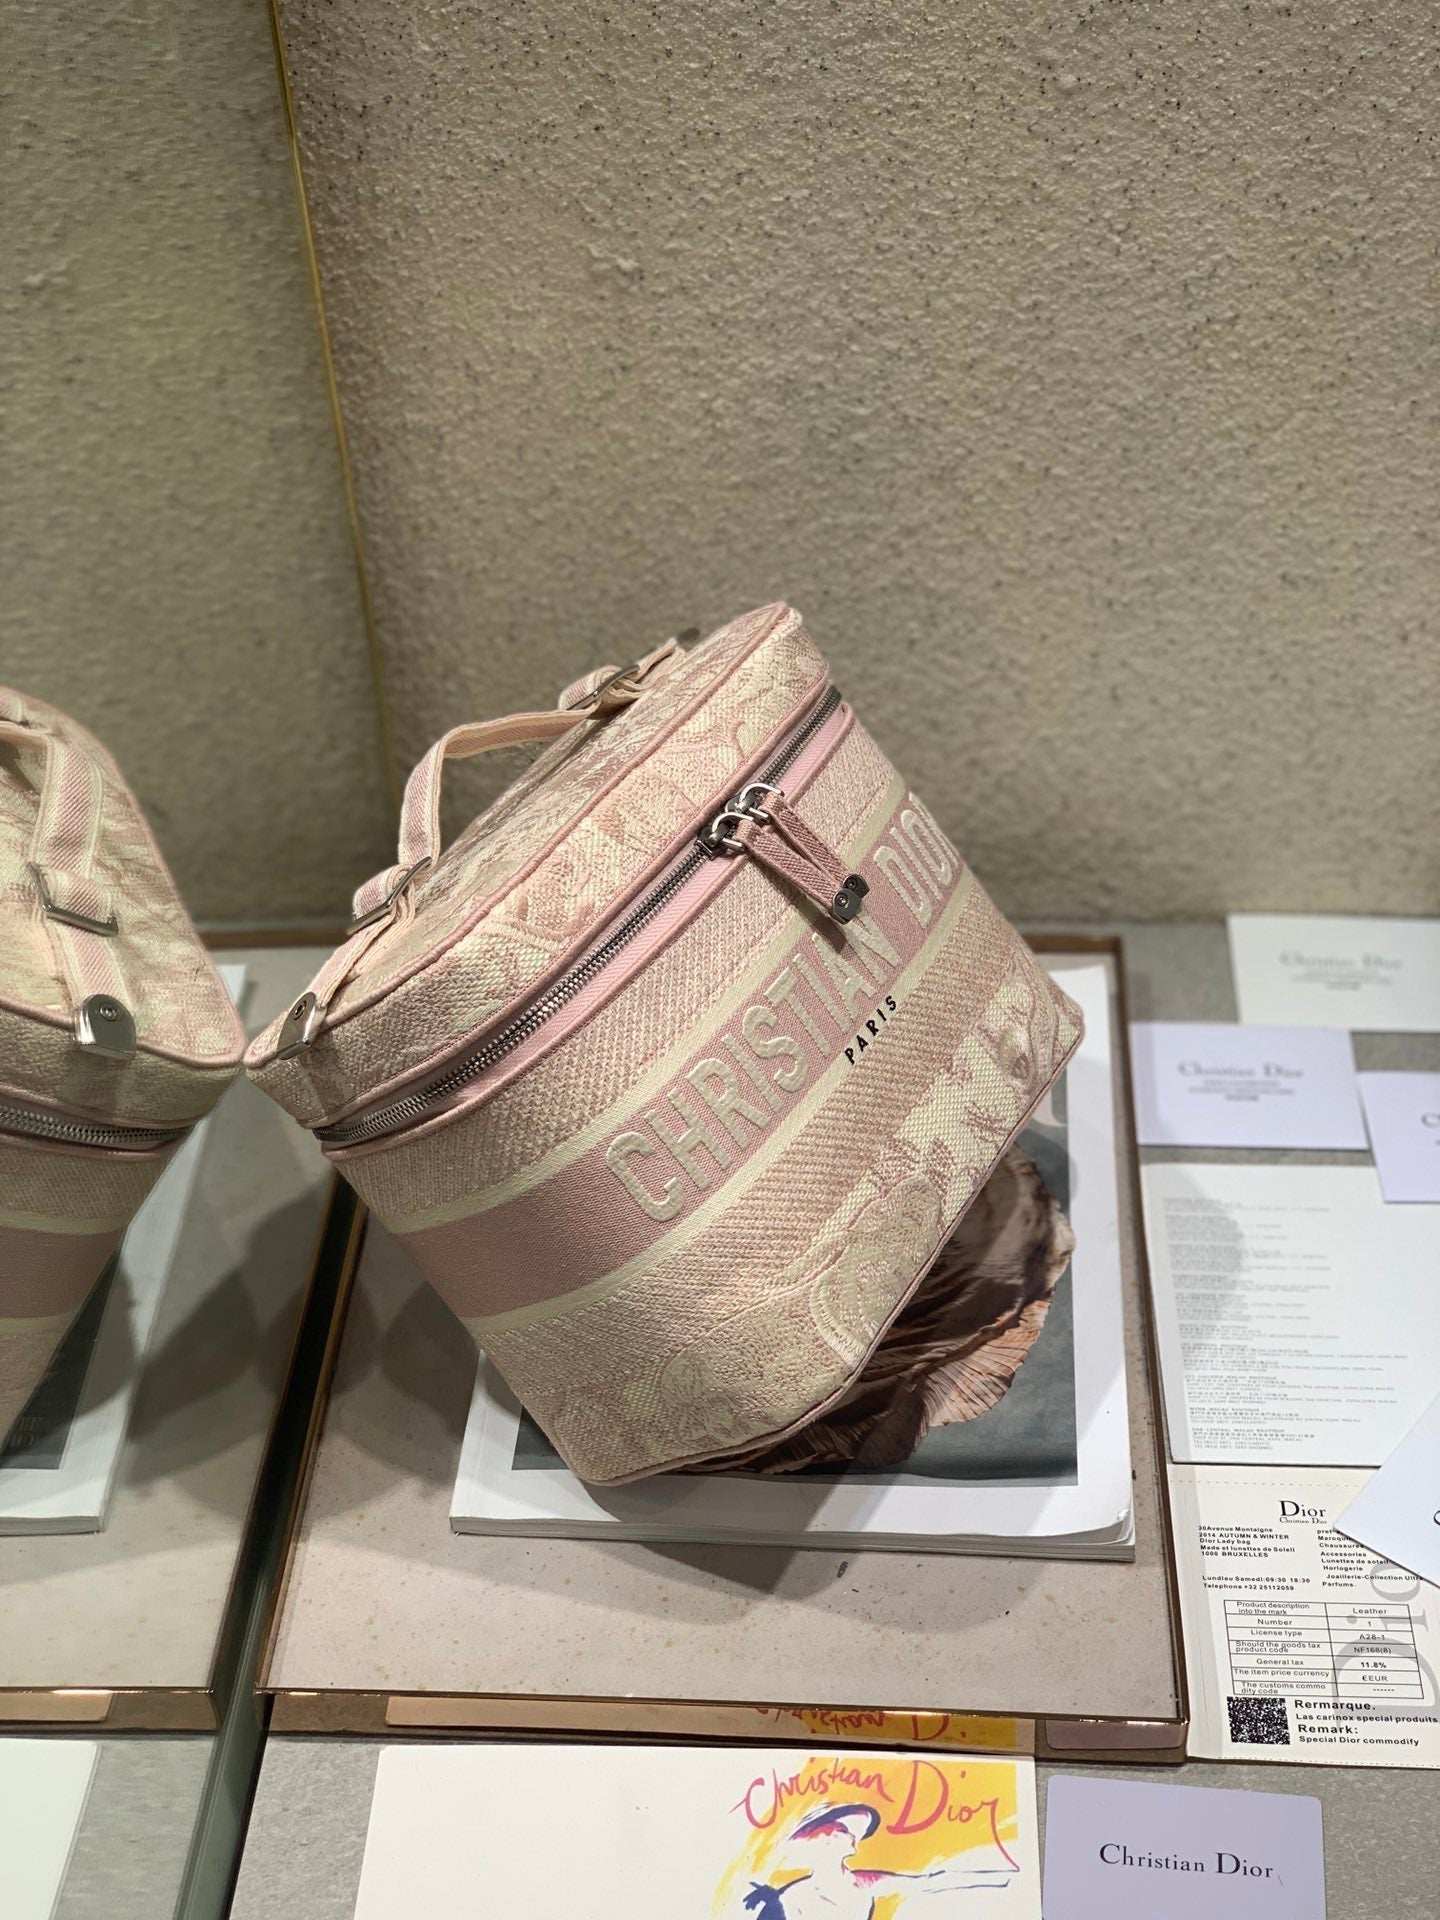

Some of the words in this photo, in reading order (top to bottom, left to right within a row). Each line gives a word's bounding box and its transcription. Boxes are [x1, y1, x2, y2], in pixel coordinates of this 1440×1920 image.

[845, 995, 897, 1065] PARIS
[606, 905, 902, 1222] CHRISTIAN
[1279, 1500, 1326, 1517] Dior
[1241, 1687, 1256, 1695] dity
[1294, 1700, 1376, 1711] Rermarque.
[1395, 1715, 1438, 1723] produits
[1298, 1724, 1359, 1734] Remark:
[1299, 1735, 1337, 1743] Special
[1363, 1737, 1419, 1746] commodify
[729, 1757, 894, 1829] Christian
[886, 1760, 1020, 1870] Dior
[1099, 1843, 1204, 1872] Christian
[1215, 1851, 1274, 1878] Dior
